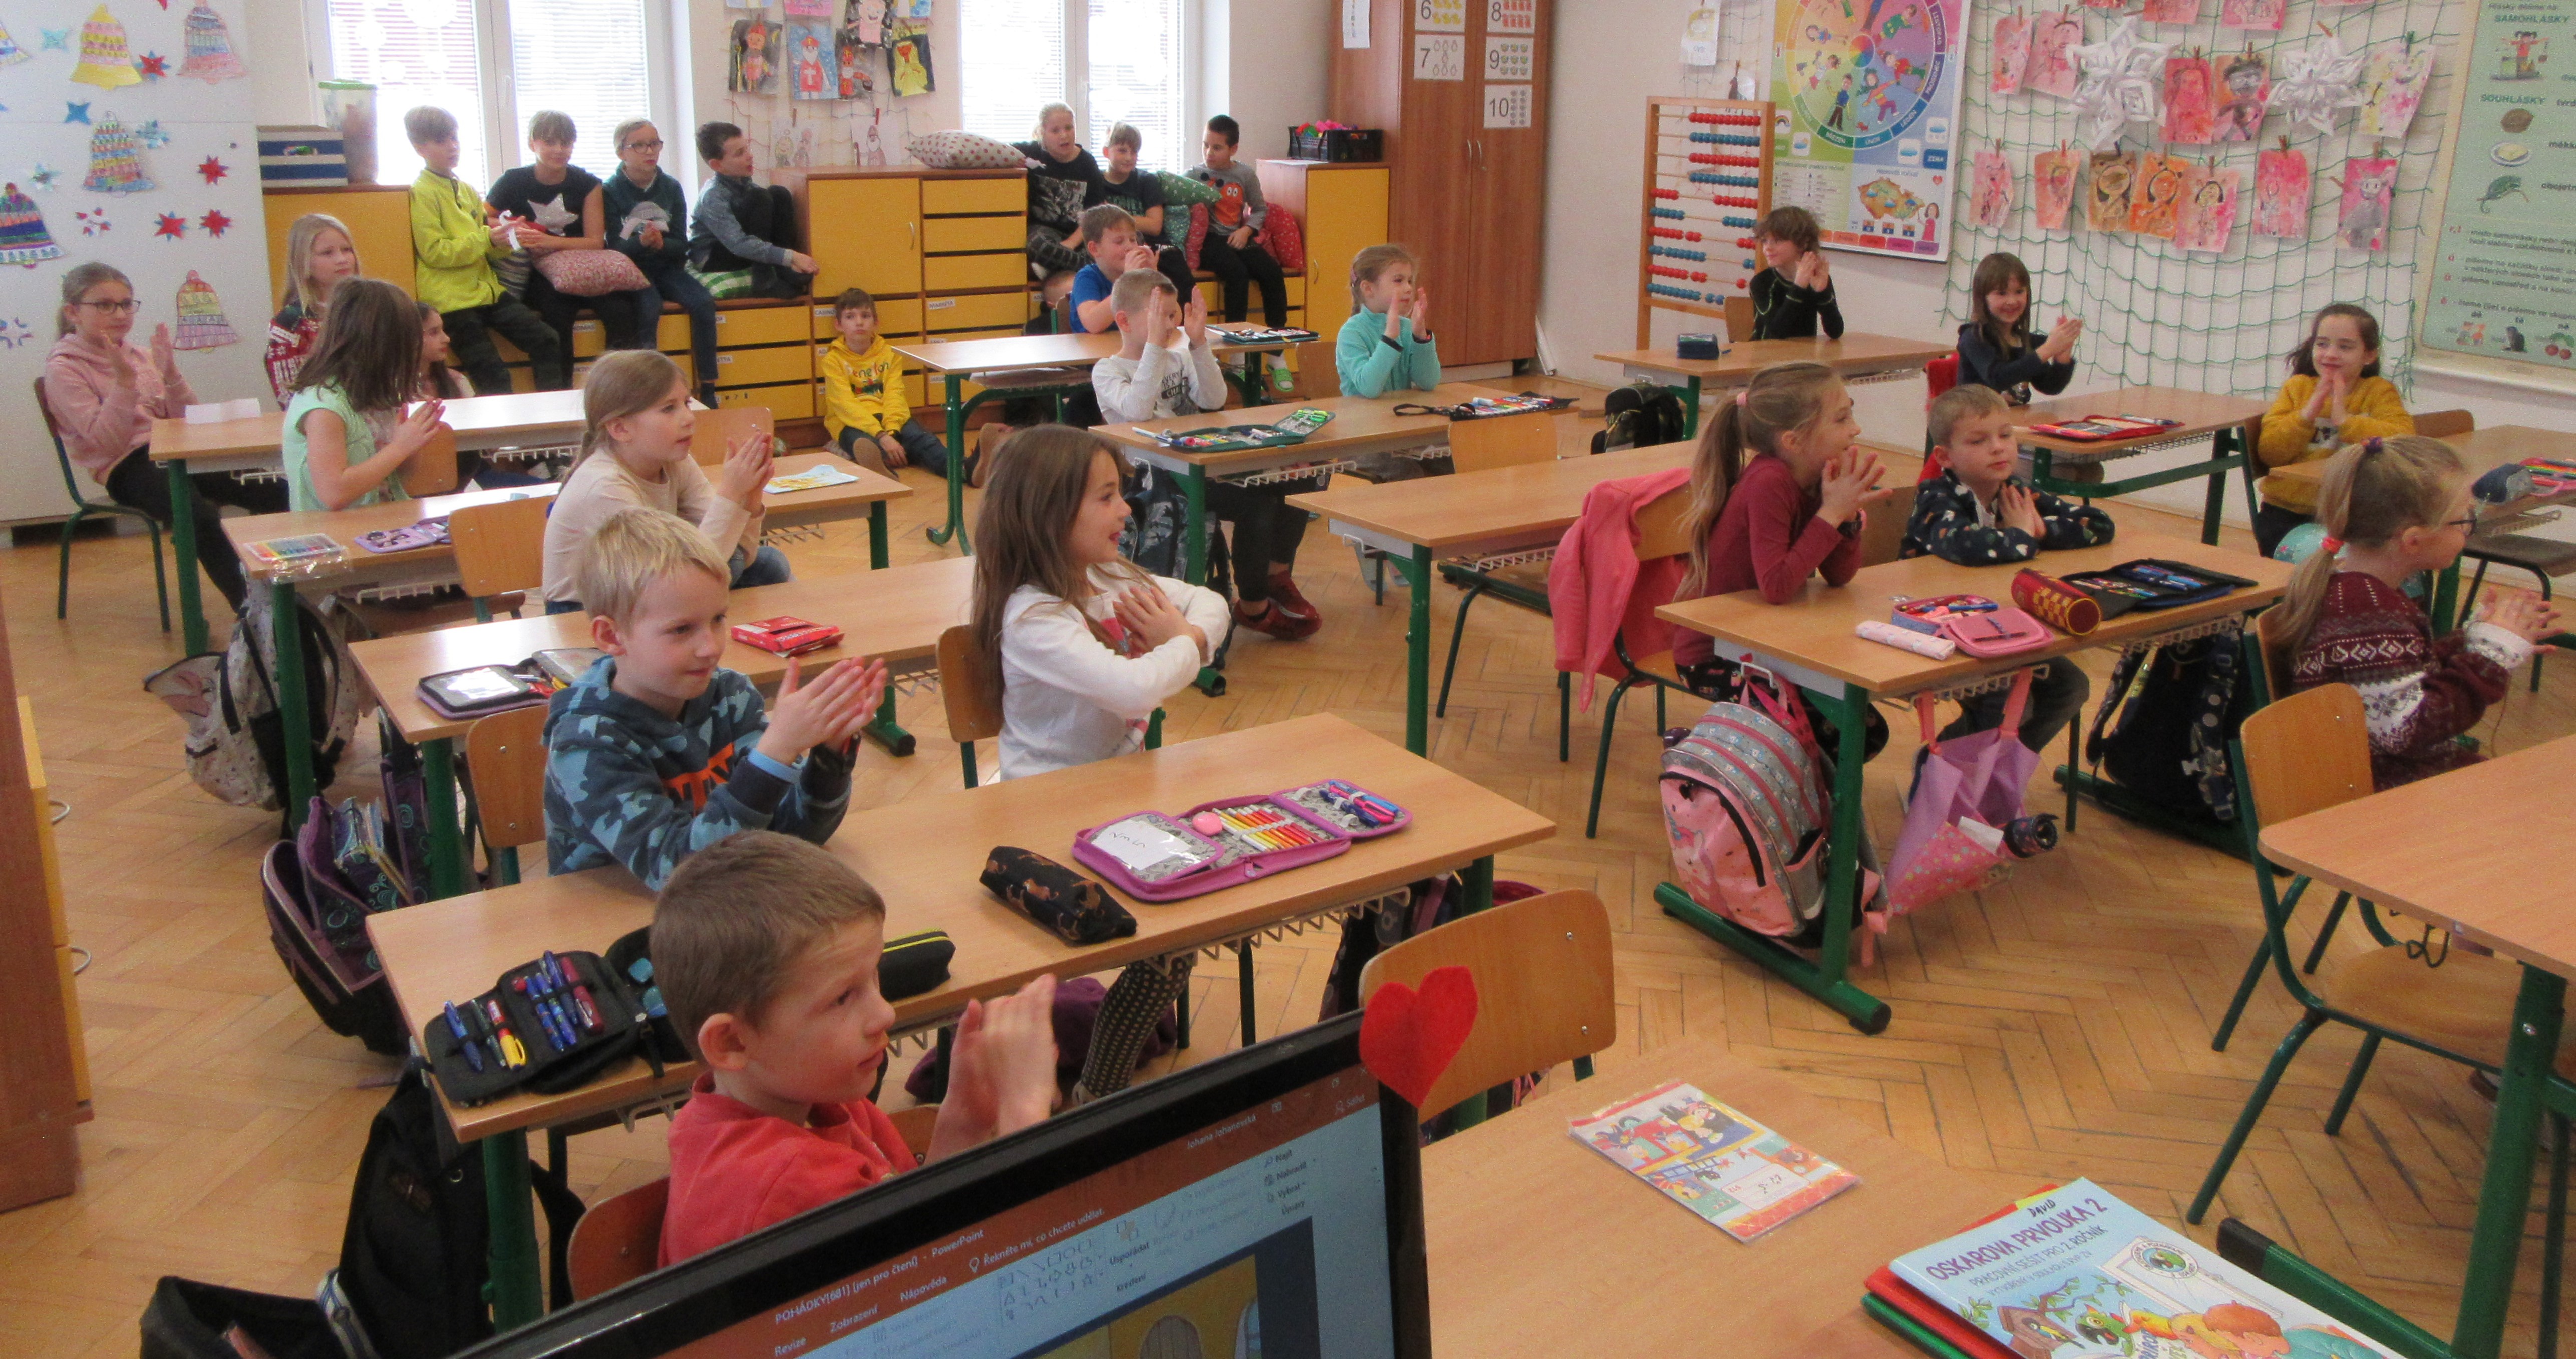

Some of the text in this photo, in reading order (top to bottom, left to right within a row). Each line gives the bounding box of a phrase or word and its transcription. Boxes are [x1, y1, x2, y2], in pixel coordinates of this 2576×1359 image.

[1421, 0, 1431, 19] 6
[1492, 2, 1501, 21] 8
[1421, 48, 1431, 68] 7
[1490, 50, 1500, 69] 9
[1489, 98, 1509, 117] 10
[1187, 1134, 1213, 1150] Johana
[2027, 1199, 2056, 1218] DAVID
[1036, 1233, 1047, 1243] co
[1048, 1220, 1076, 1237] chcete
[1926, 1198, 2108, 1280] OSKAROVA PRVOUKA 2
[873, 1270, 890, 1286] pro
[931, 1229, 984, 1257] PowerPoint
[1969, 1263, 2019, 1287] PRACOVNÍ
[2014, 1253, 2045, 1270] SEŠIT
[2042, 1245, 2065, 1259] PRO
[2069, 1224, 2109, 1247] ROČNÍK
[775, 1336, 807, 1356] Revize
[830, 1303, 879, 1333] Zobrazení
[900, 1276, 947, 1301] Nápověda
